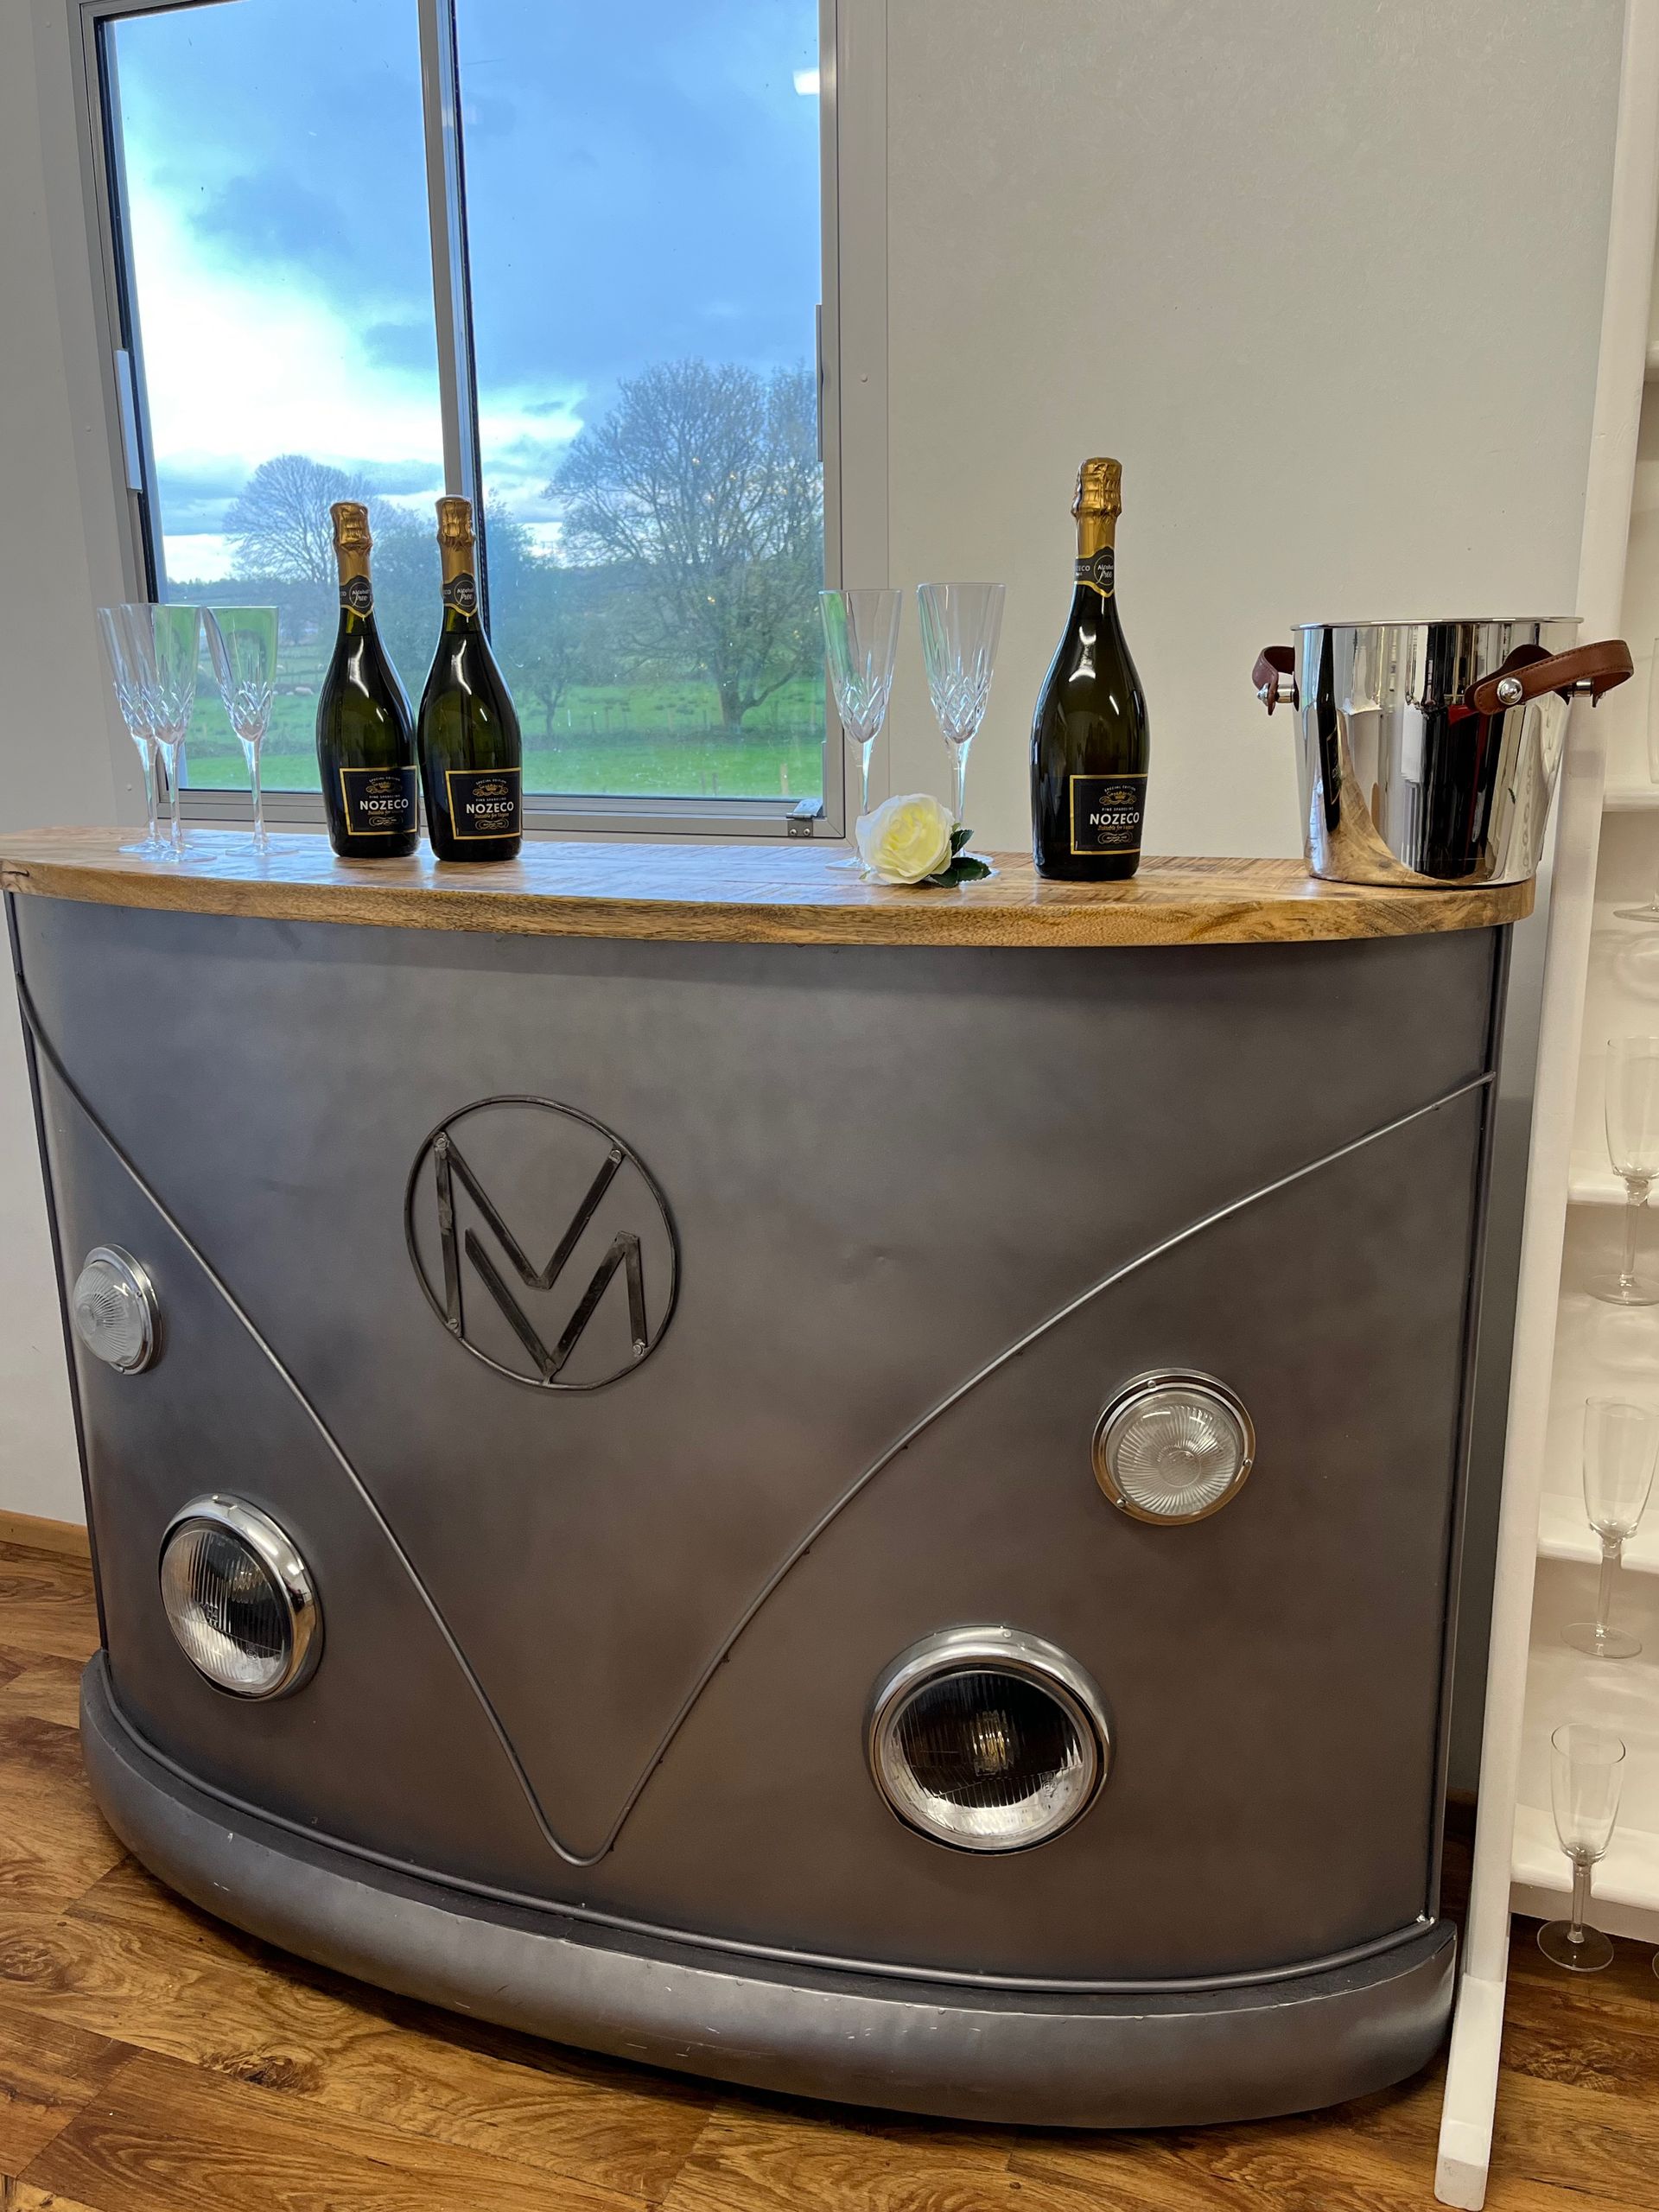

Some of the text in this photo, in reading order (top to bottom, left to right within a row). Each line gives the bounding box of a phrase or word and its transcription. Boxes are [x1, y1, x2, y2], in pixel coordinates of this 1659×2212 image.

[359, 798, 409, 810] NOZECO
[466, 801, 514, 814] NOZECO
[1090, 811, 1140, 825] NOZECO
